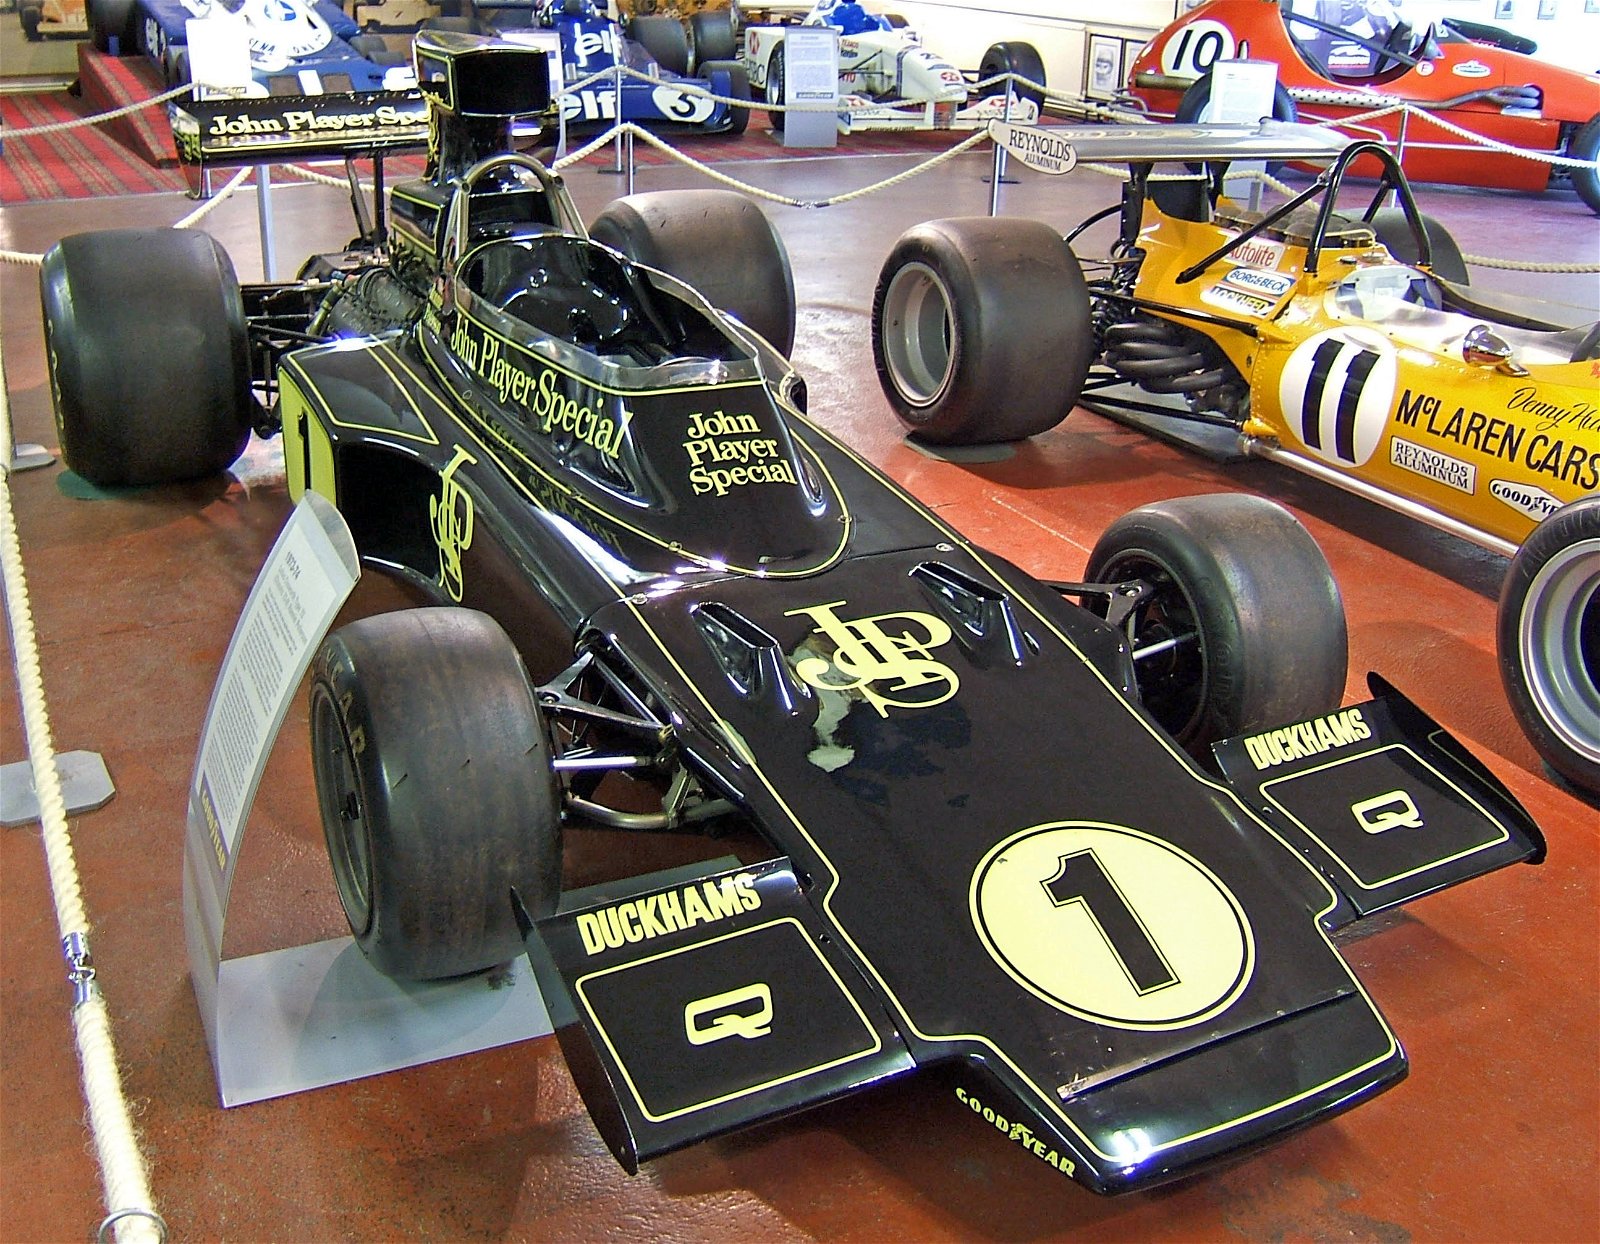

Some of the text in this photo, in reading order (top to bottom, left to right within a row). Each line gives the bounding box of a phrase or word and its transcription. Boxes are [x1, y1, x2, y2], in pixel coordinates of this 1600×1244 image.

[1172, 29, 1225, 74] 10
[209, 106, 431, 136] John Player Spe
[557, 90, 616, 121] elf
[1009, 129, 1071, 162] REYNOLDS
[1024, 153, 1061, 172] ALUMINUM
[450, 312, 479, 372] John
[478, 332, 537, 404] Player
[533, 368, 634, 459] Special
[1301, 338, 1381, 464] 11
[687, 411, 761, 439] John
[1507, 387, 1571, 431] Denny
[683, 437, 779, 467] Player
[1394, 453, 1469, 490] ALUMINUM
[1395, 442, 1468, 477] REYNOLDS
[1525, 434, 1600, 490] CARS
[689, 459, 798, 497] Special
[1492, 483, 1558, 514] GOODYE
[1244, 708, 1371, 771] DUCKHAMS
[1351, 790, 1424, 834] Q
[576, 872, 762, 956] DUCKHAMS
[1039, 847, 1182, 997] 1
[684, 983, 774, 1045] Q
[955, 1087, 1076, 1178] GOODYEAR
